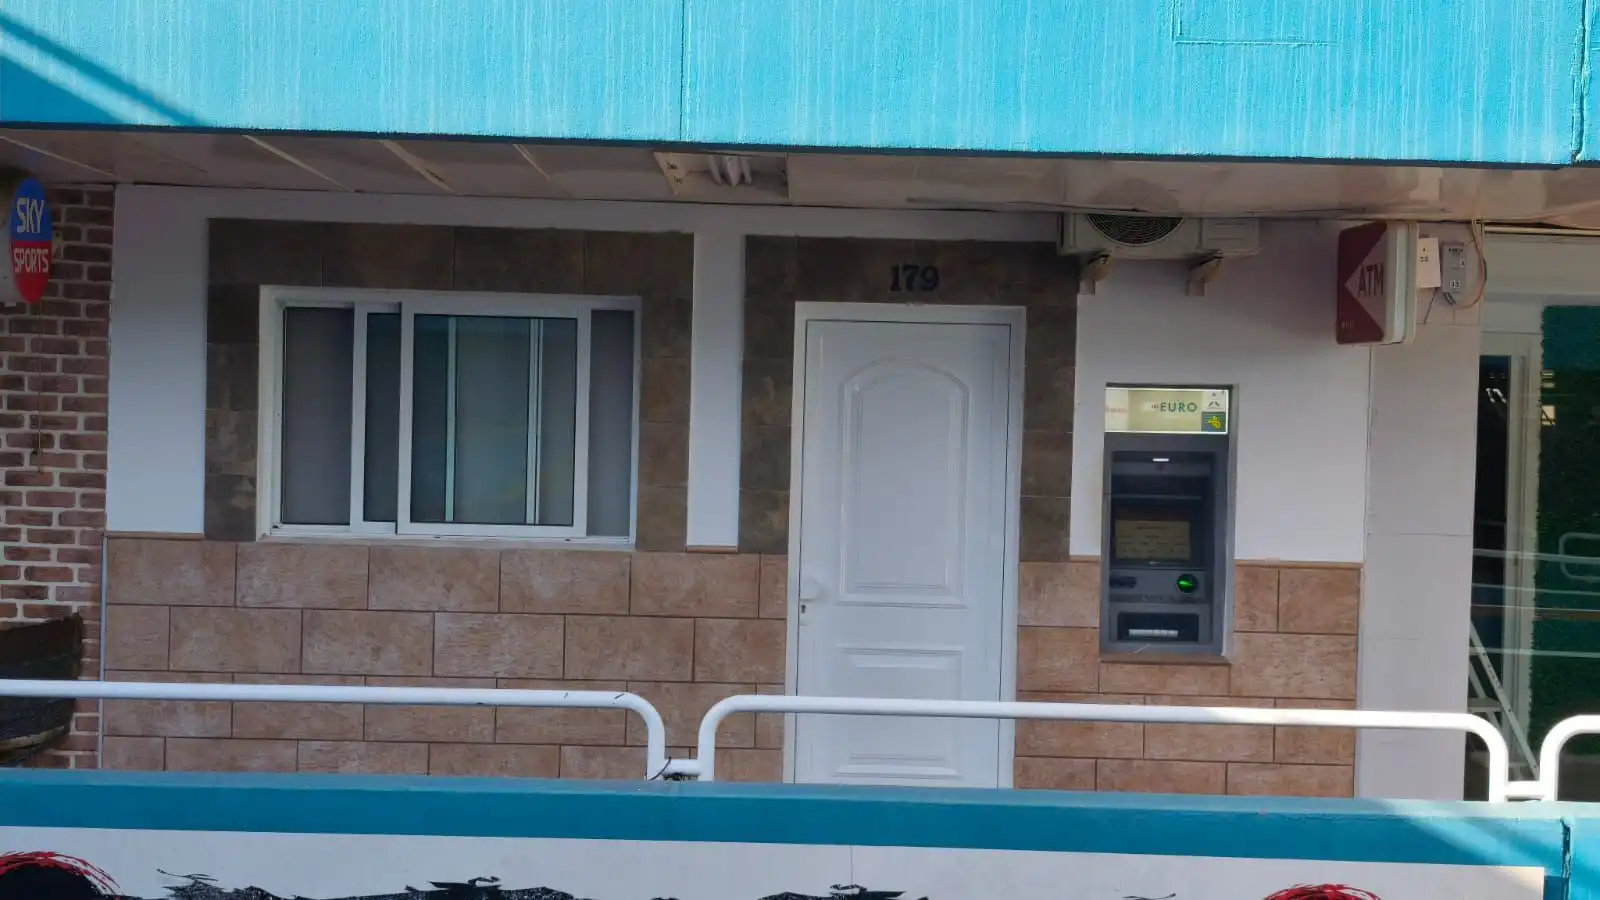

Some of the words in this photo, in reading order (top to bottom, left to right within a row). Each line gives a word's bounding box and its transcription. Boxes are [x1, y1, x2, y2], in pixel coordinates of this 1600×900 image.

[16, 197, 45, 234] SKY
[13, 247, 49, 274] SPORTS
[889, 263, 940, 293] 179
[1357, 263, 1384, 298] ATM
[1160, 402, 1198, 413] EURO
